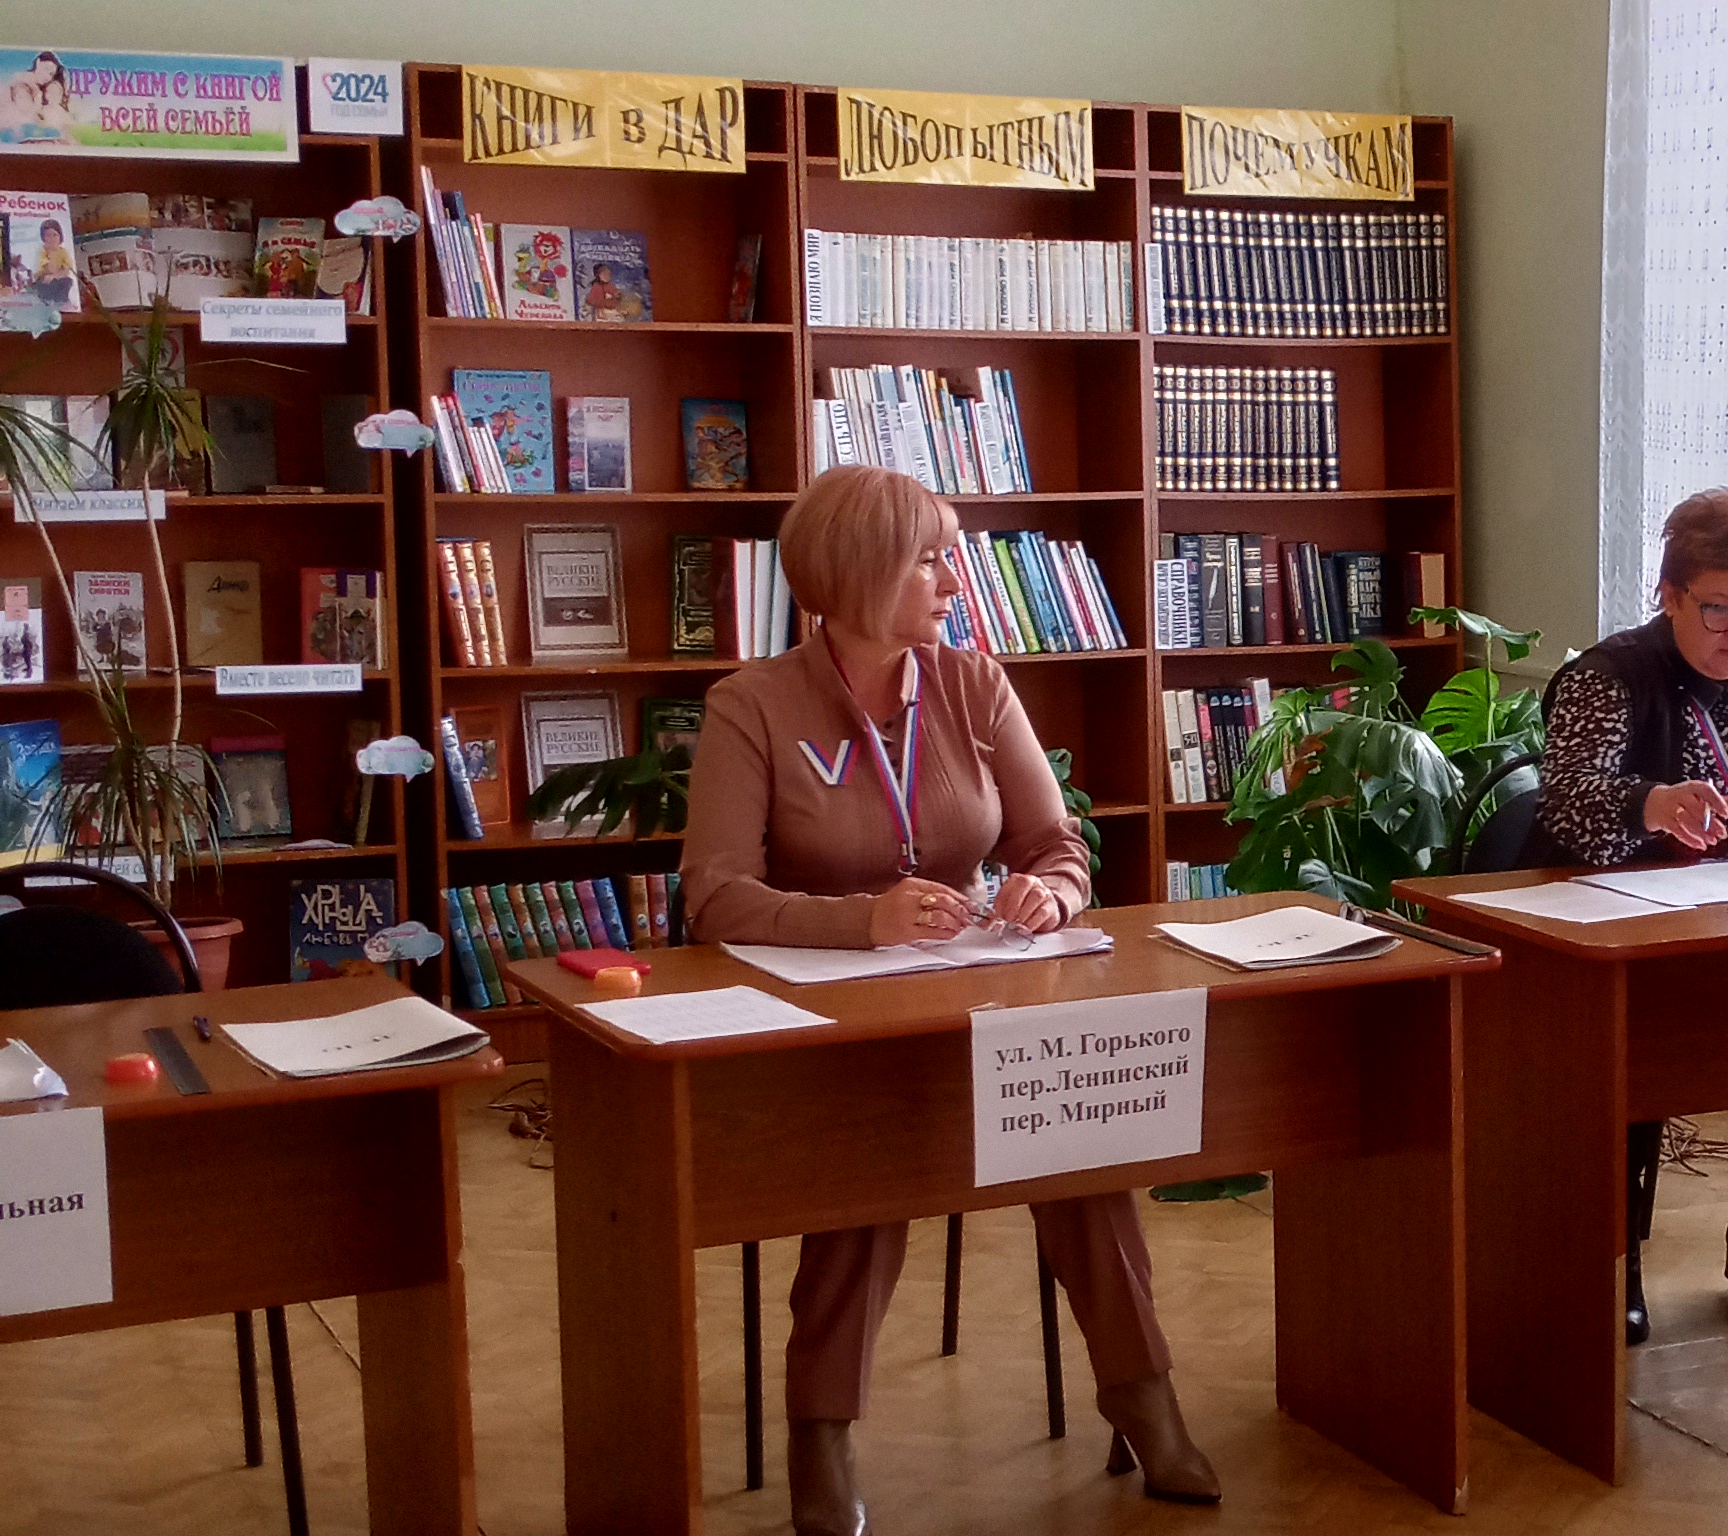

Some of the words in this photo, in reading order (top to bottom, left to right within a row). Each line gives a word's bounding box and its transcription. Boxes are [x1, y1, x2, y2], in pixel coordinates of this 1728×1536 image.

[69, 67, 168, 98] ДРУЖИМ
[173, 71, 189, 98] С
[194, 70, 282, 101] КНИГОЙ
[331, 72, 389, 103] 2024
[100, 103, 159, 133] ВСЕЙ
[164, 105, 252, 137] СЕМЬЁЙ
[466, 72, 596, 162] КНИГИ
[658, 85, 740, 168] ДАР
[844, 96, 1088, 187] ЛЮБОПЫТНЫМ
[1186, 113, 1410, 198] ПОЧЕМУЧКАМ
[0, 195, 67, 211] Ребенок
[807, 232, 821, 258] МИР
[808, 261, 822, 313] ПОЗНАЮ
[201, 301, 262, 319] Секреты
[1170, 561, 1187, 645] СПРАВОЧНИКИ
[995, 1047, 1032, 1071] ул.
[1039, 1037, 1072, 1060] М.
[1079, 1025, 1191, 1059] Горького
[1000, 1054, 1189, 1099] пер.Ленинский
[1000, 1113, 1051, 1134] пер.
[1060, 1090, 1167, 1125] Мирный
